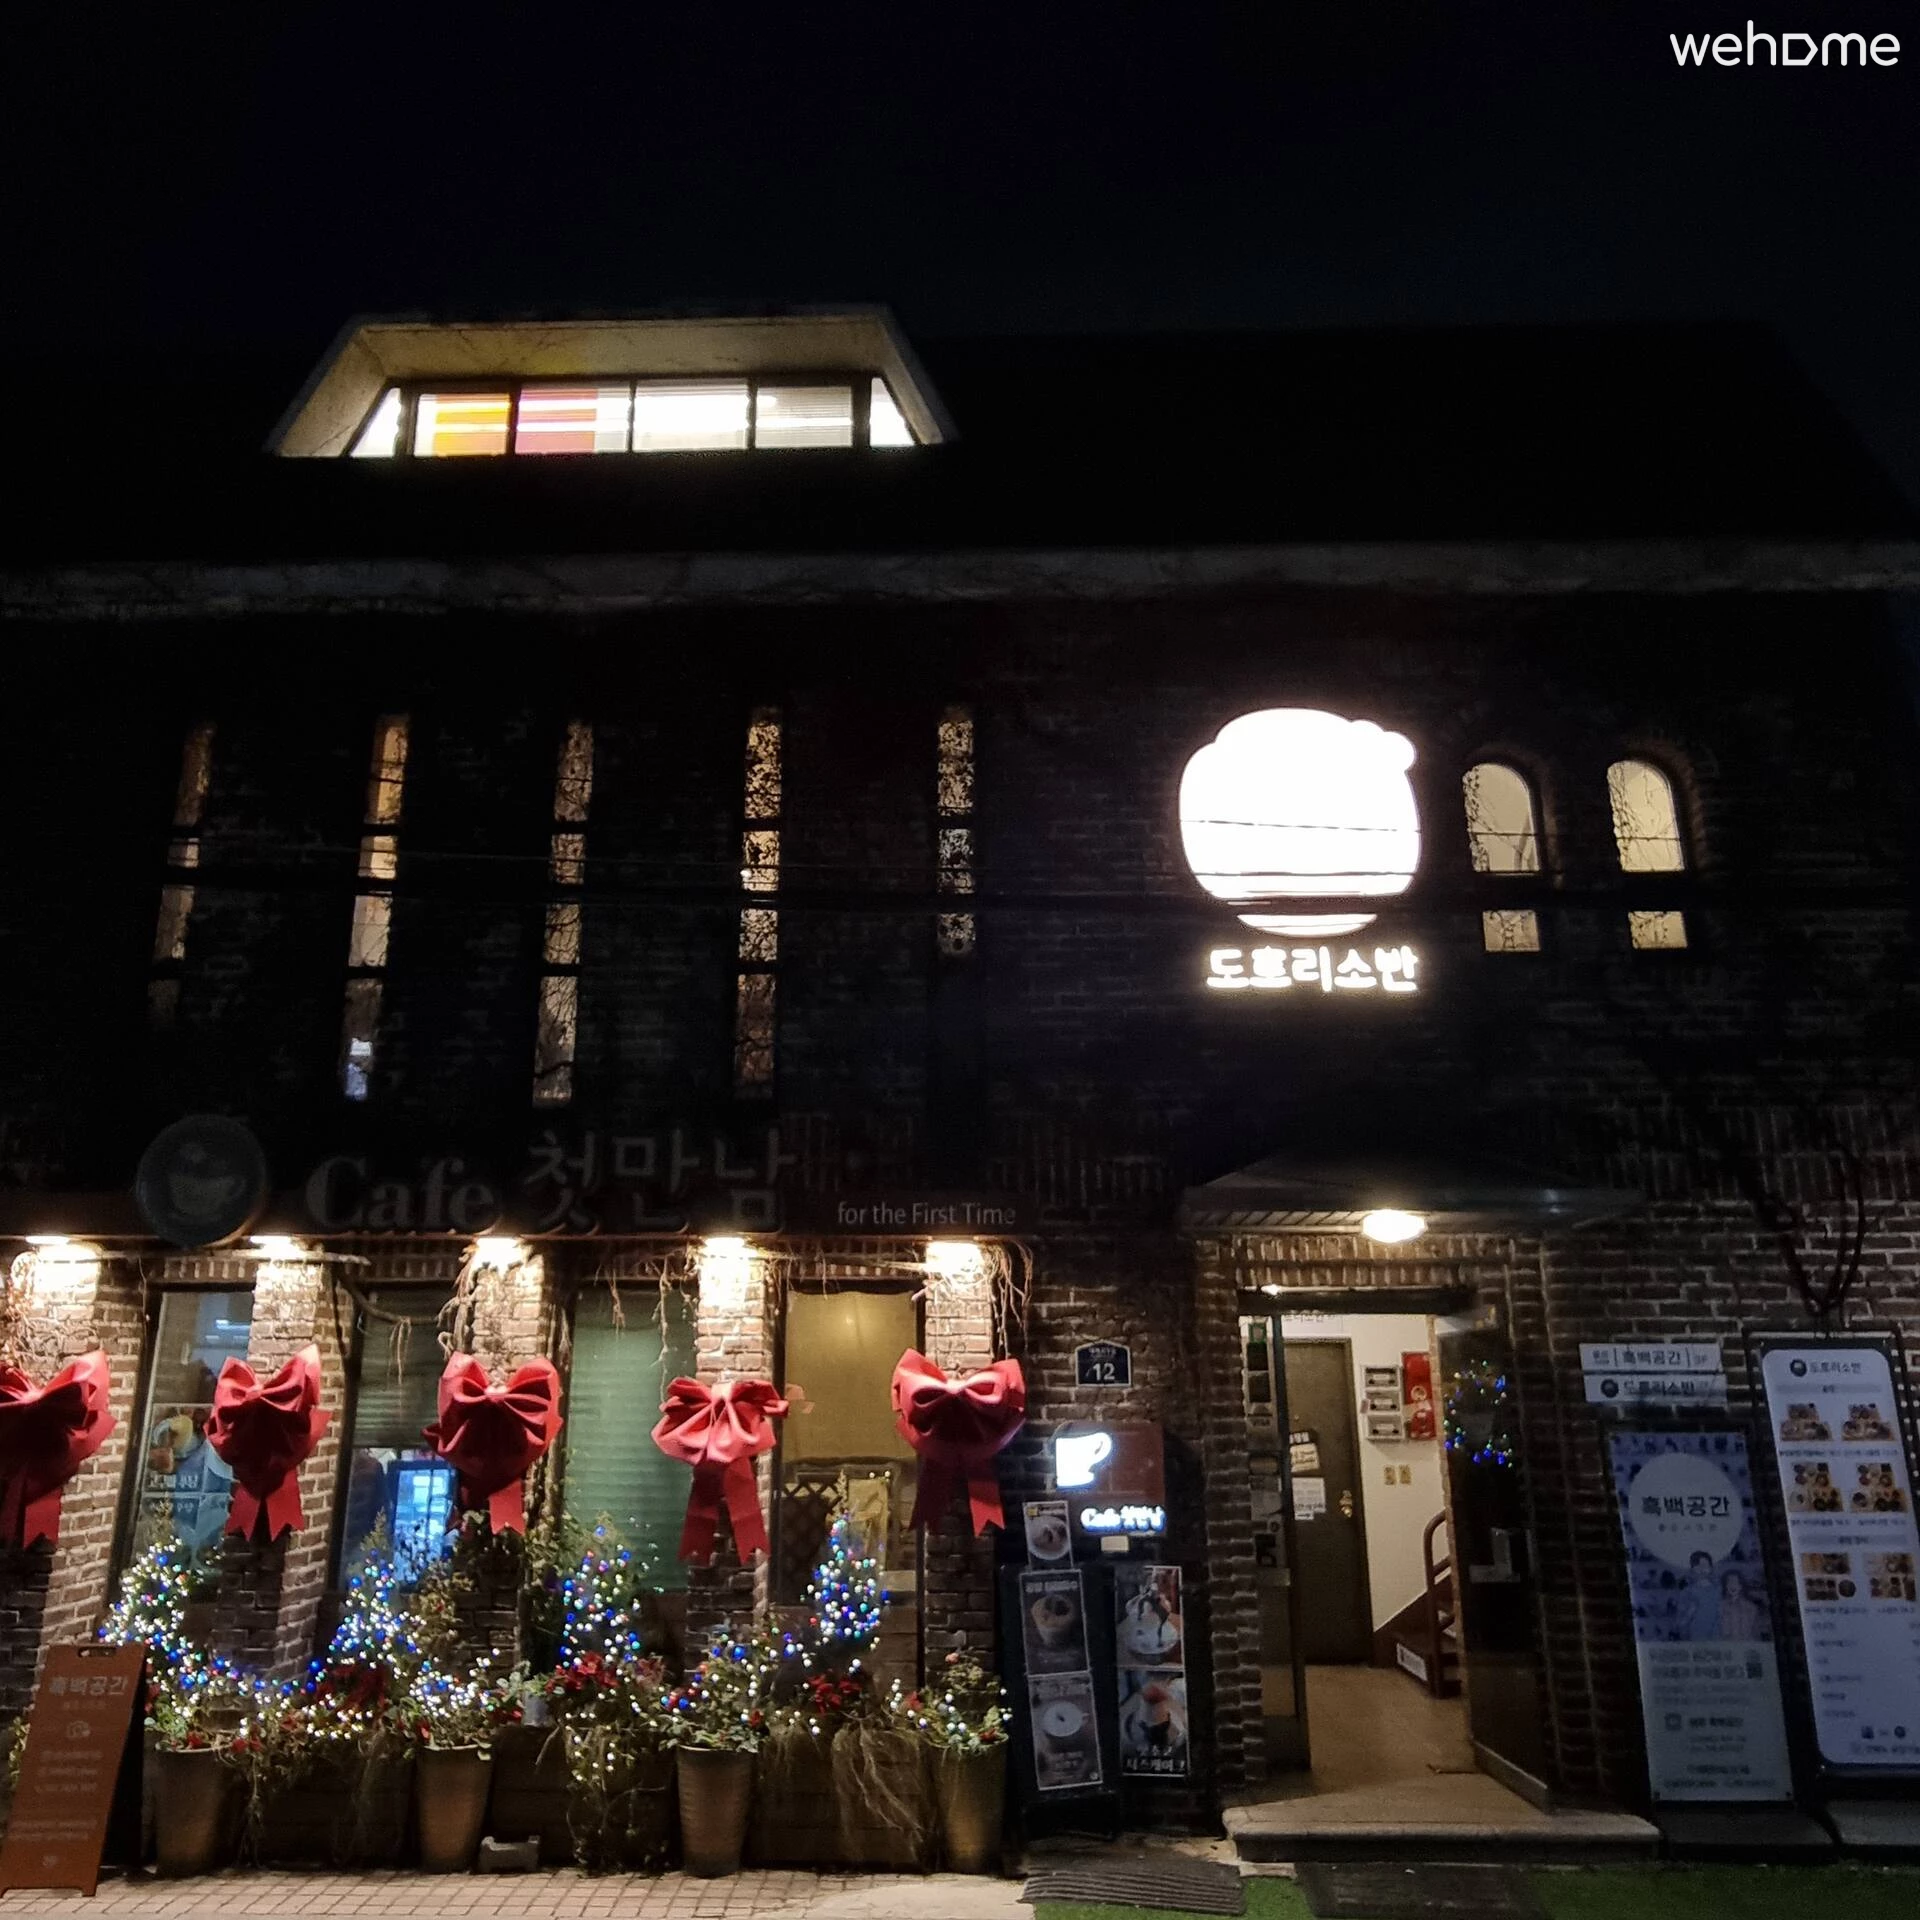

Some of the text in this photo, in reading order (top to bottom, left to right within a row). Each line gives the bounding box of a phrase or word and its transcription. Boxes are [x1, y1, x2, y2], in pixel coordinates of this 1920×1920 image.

[304, 1126, 800, 1235] Cafe 첫만남
[837, 1202, 1017, 1226] for the First Time
[1092, 1362, 1116, 1381] 12
[1641, 1495, 1730, 1517] 흑백공간
[49, 1675, 129, 1696] 흑백공간
